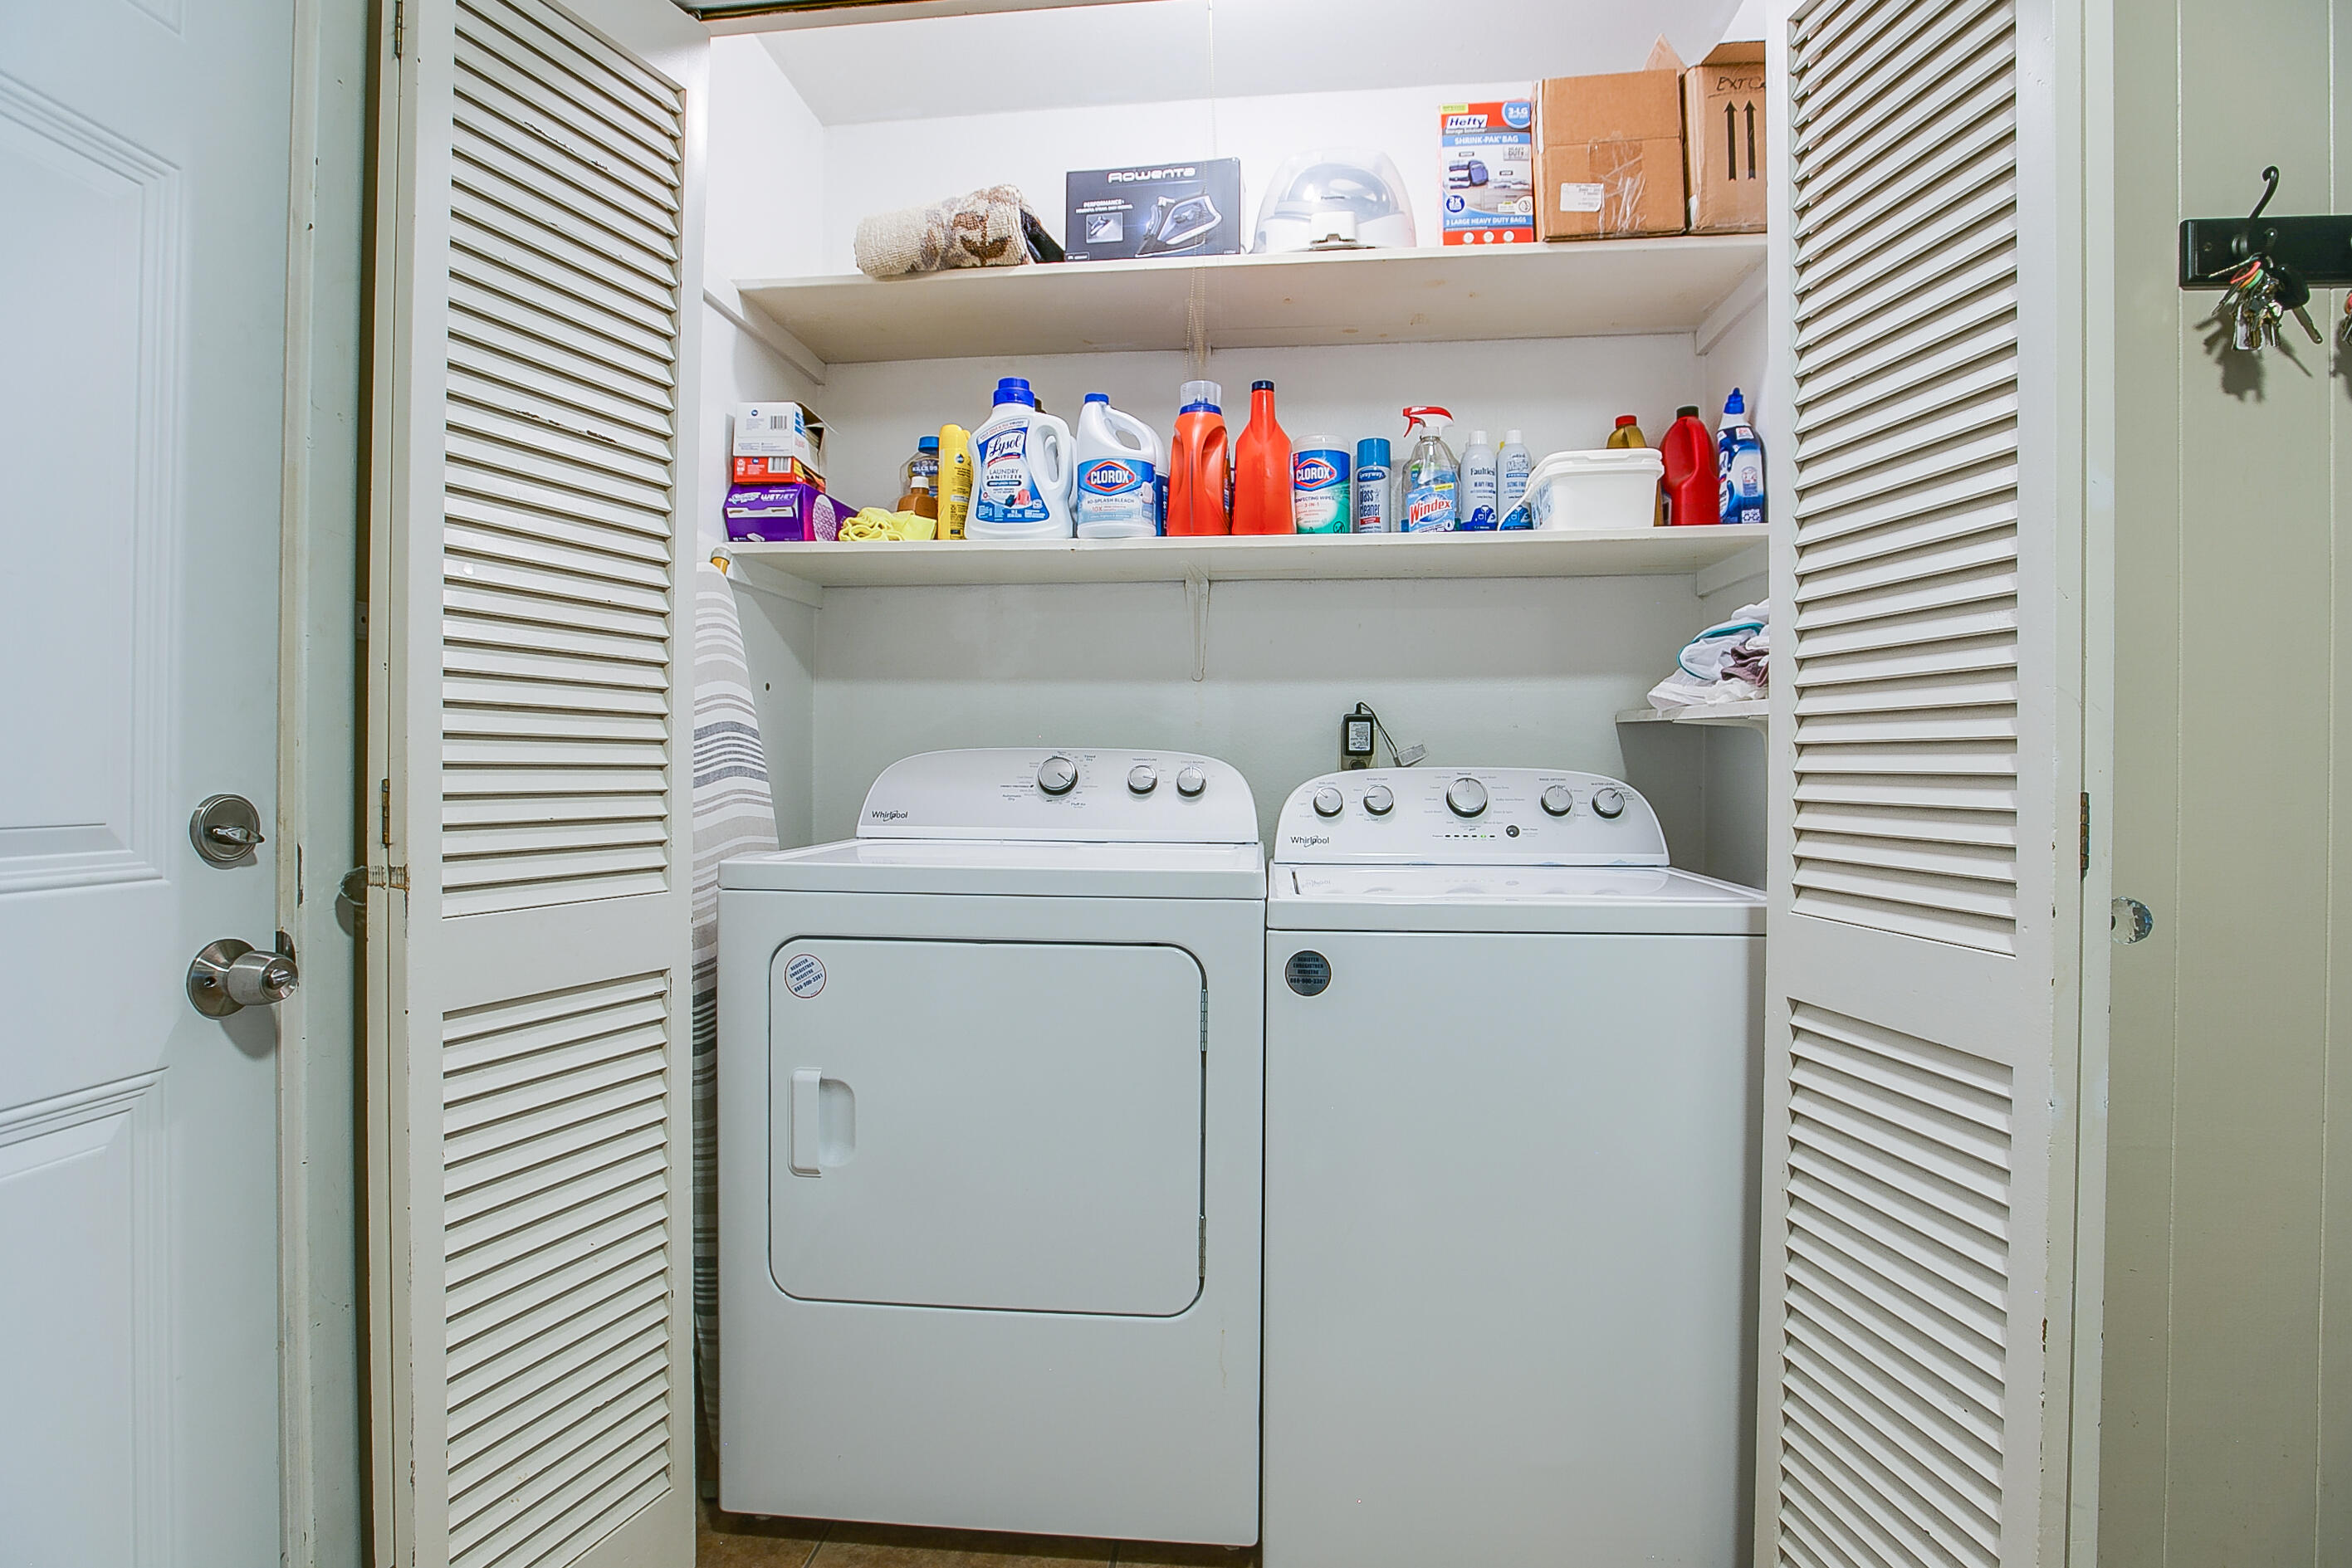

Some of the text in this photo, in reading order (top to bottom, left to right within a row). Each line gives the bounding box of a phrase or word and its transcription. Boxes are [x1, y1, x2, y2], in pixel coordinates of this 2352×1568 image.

[1450, 117, 1484, 129] Hefty
[989, 435, 1022, 457] Lysol
[1090, 470, 1130, 485] CLOROX
[1296, 466, 1330, 481] CLOROX
[1411, 498, 1451, 525] Windex
[872, 810, 908, 822] Whirlpool
[1290, 835, 1330, 848] Whirlpool
